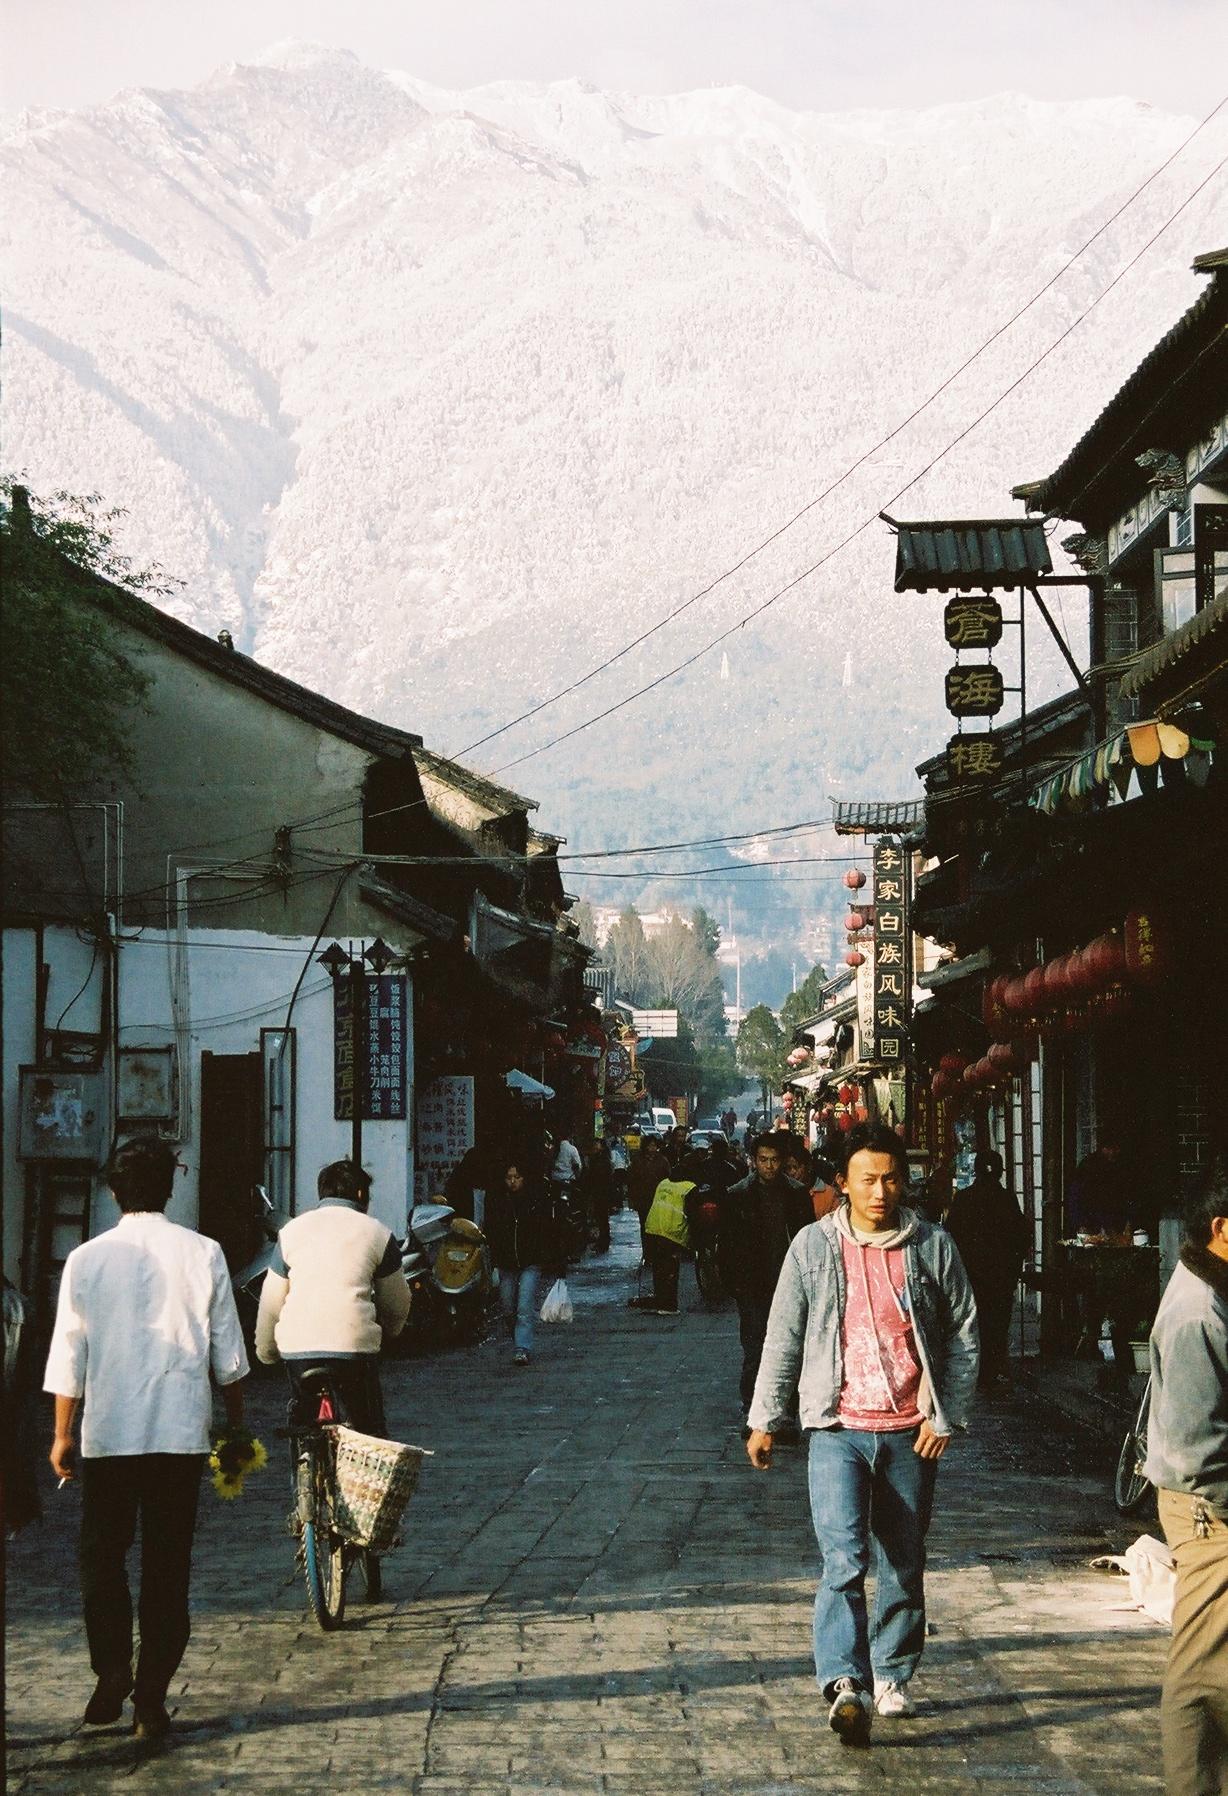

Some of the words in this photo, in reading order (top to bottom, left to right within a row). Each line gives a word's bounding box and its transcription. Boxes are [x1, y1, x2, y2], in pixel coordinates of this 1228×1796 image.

[946, 603, 1001, 776] 蒼海樓
[877, 848, 902, 1057] 李家白族风味园
